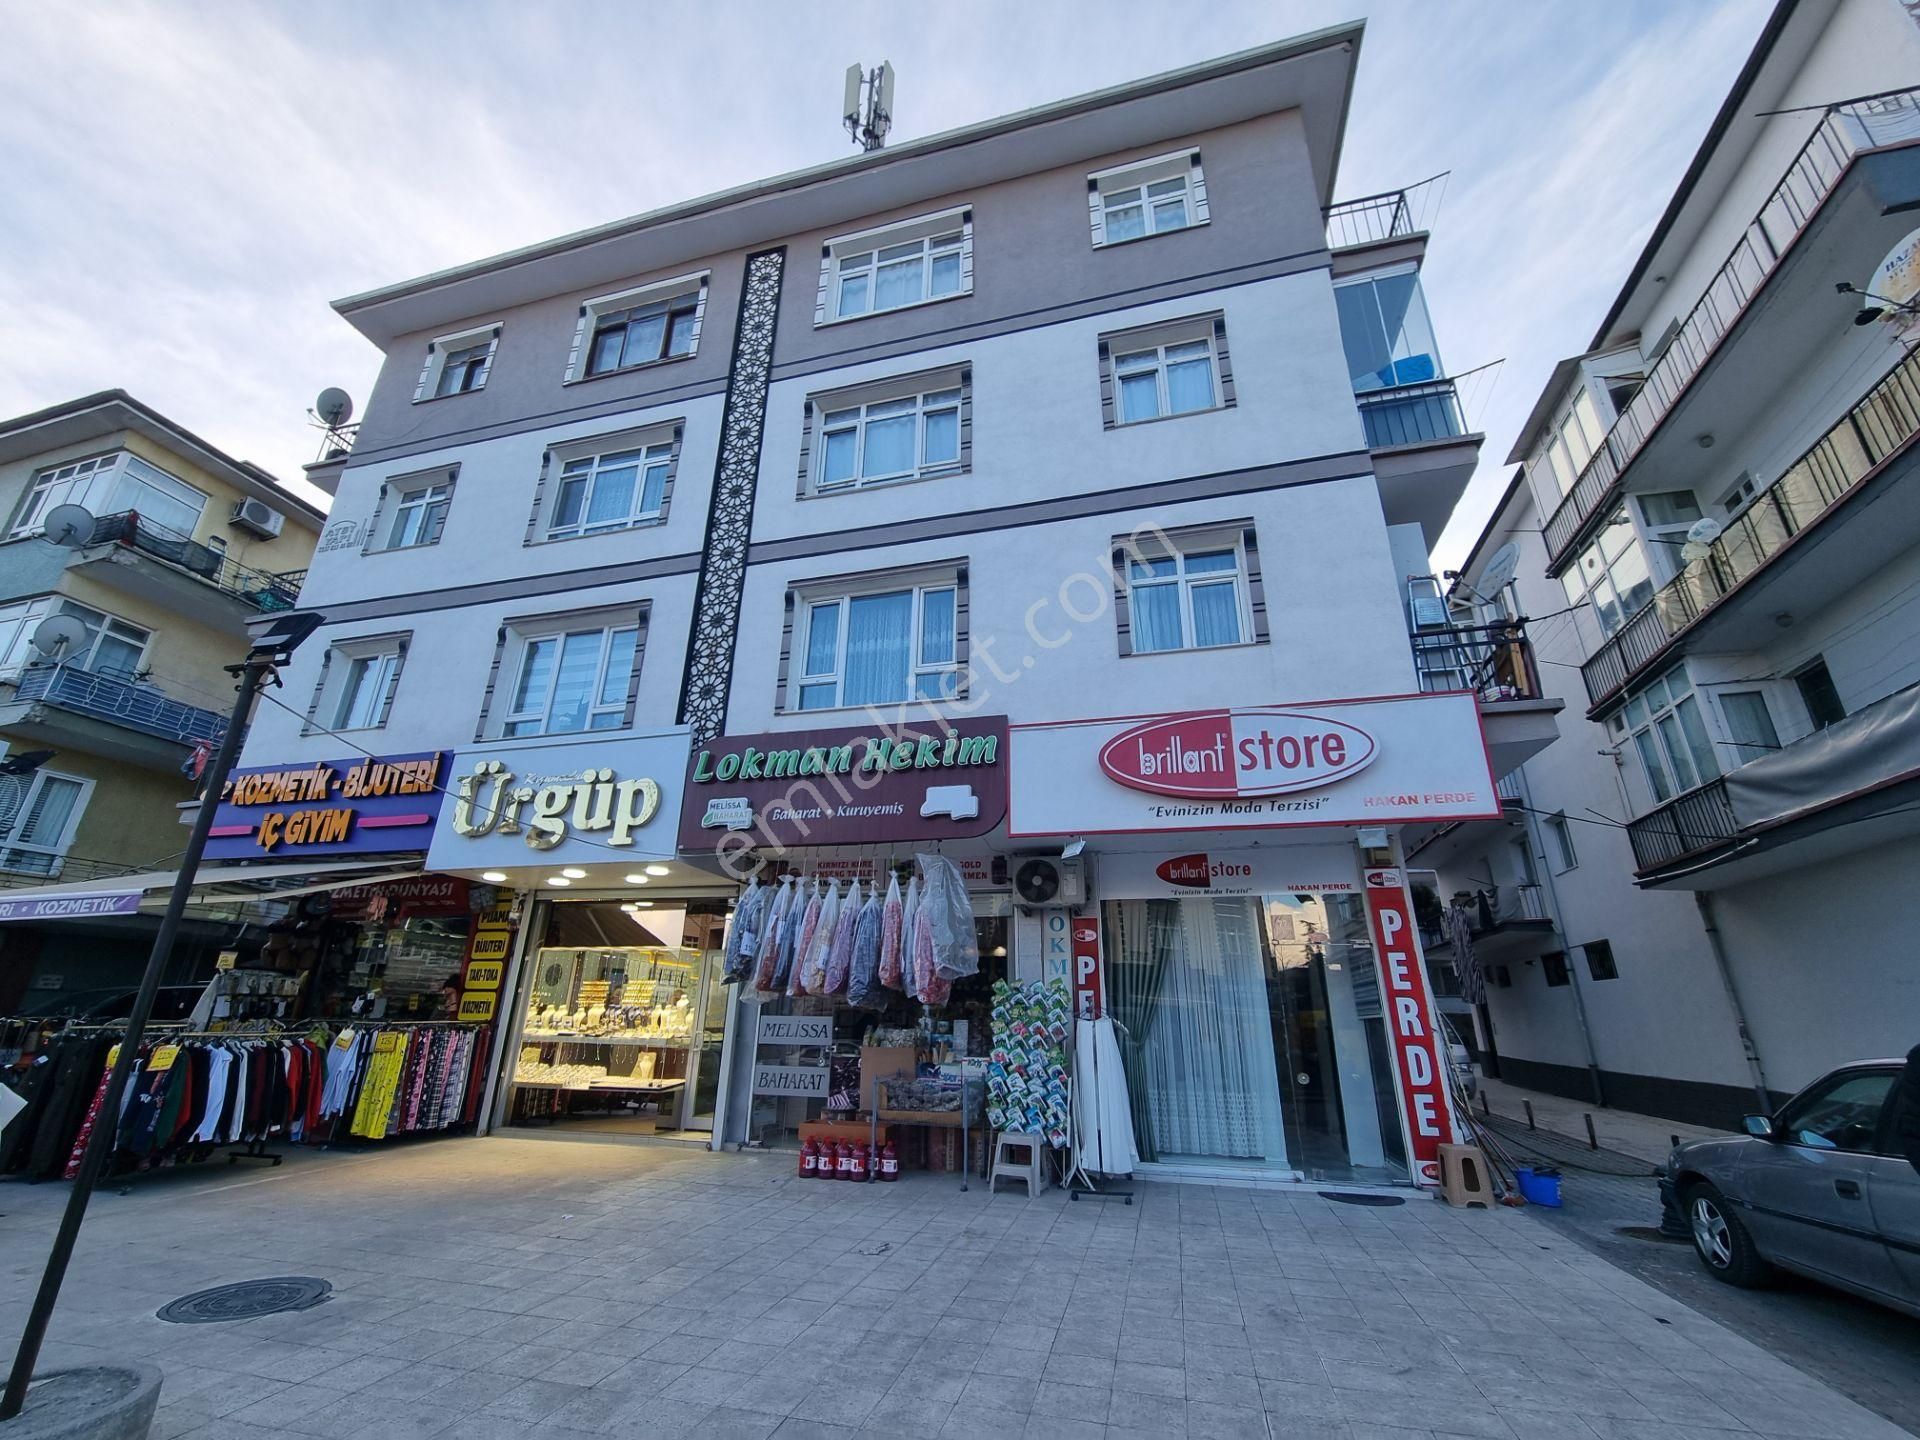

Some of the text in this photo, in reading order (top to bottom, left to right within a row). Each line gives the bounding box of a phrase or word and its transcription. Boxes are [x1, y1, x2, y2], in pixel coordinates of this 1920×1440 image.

[1138, 729, 1347, 776] brillant store
[692, 746, 853, 784] Lokman
[231, 761, 335, 807] KOZMETİK
[341, 752, 442, 798] BİJUTERİ
[452, 760, 662, 851] Ürgüp
[709, 800, 742, 810] MELİSSA
[1220, 801, 1262, 815] Moda
[1363, 791, 1478, 808] HAKAN PERDE
[771, 801, 905, 821] Baharat Kuruyemiş
[256, 807, 353, 852] İÇ GİYİM
[1169, 861, 1252, 879] brillant store
[1287, 883, 1353, 892] HAKAN PERDE
[33, 897, 119, 915] KOZMETİK
[474, 937, 507, 953] BİJUTERİ
[468, 968, 499, 982] TAKI-TOKA
[461, 996, 492, 1014] KOZMETİK
[763, 1020, 829, 1039] MELİSSA
[1379, 908, 1441, 1138] PERDE
[758, 1071, 826, 1091] BAHARAT
